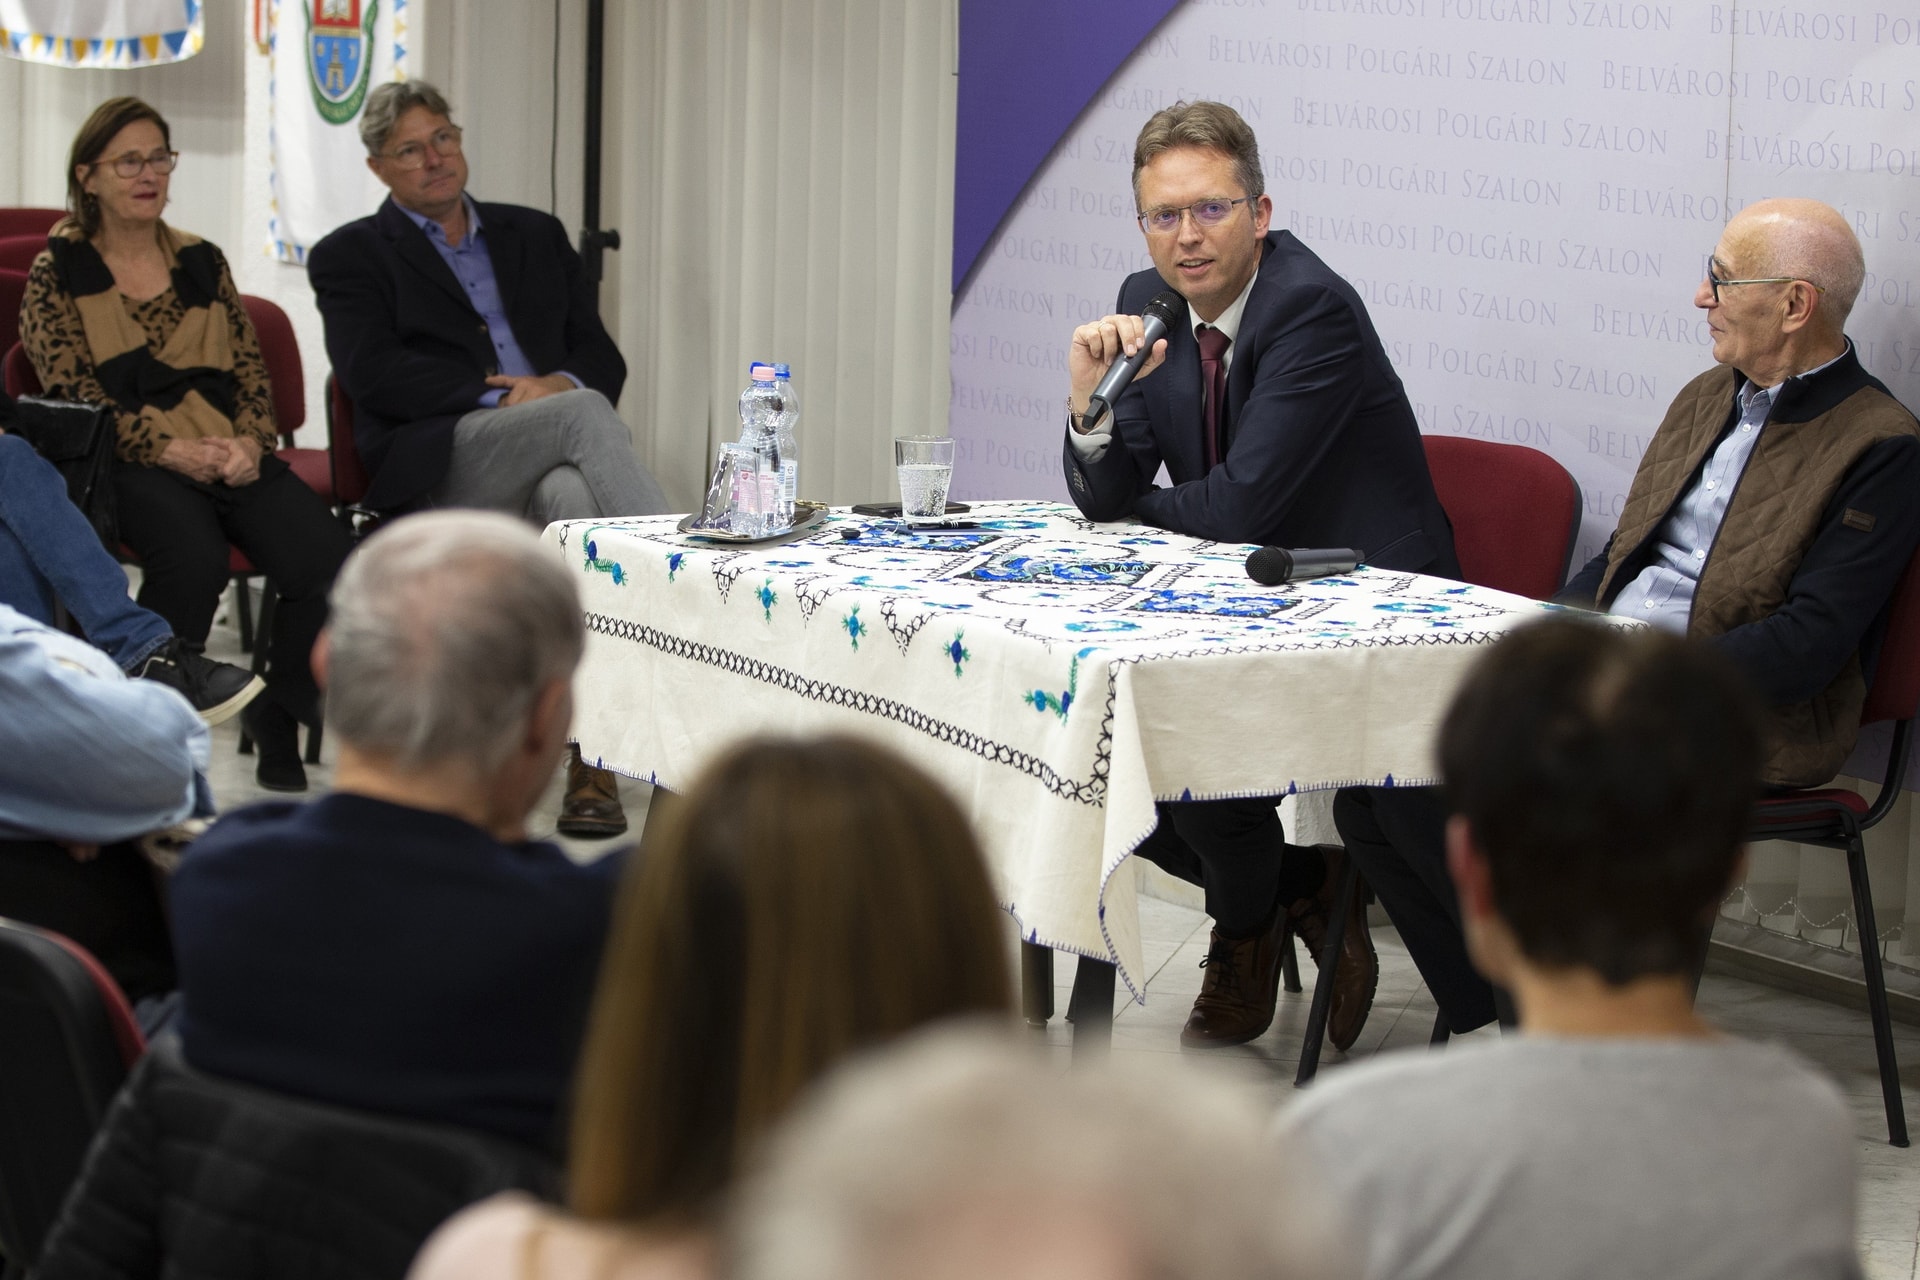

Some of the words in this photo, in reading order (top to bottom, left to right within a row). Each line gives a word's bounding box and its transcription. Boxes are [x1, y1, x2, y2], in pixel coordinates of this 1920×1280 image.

[1566, 0, 1673, 32] SZALON
[1710, 4, 1857, 42] BELVÁROSI
[1208, 34, 1331, 69] BELVÁROSI
[1346, 43, 1453, 78] POLGÁRI
[1466, 51, 1567, 86] SZALON
[1602, 59, 1751, 98] BELVÁROSI
[1766, 70, 1887, 109] POLGÁRI
[1293, 96, 1421, 134] BELVÁROSI
[1437, 108, 1547, 145] POLGÁRI
[1562, 117, 1668, 154] SZALON
[1705, 129, 1852, 171] BELVÁROSI
[1342, 158, 1447, 195] POLGÁRI
[1461, 169, 1562, 206] SZALON
[1289, 209, 1417, 250] BELVÁROSI
[1432, 224, 1543, 265] POLGÁRI
[1557, 238, 1662, 278] SZALON
[1003, 236, 1079, 266] OLGÁRI
[1352, 278, 1442, 312] OLGÁRI
[1457, 287, 1558, 327] SZALON
[1592, 303, 1712, 346] BELVÁRO
[959, 385, 1050, 421] ELVÁROSI
[989, 335, 1067, 372] POLGÁR
[1452, 403, 1552, 446] SZALON
[1427, 341, 1537, 384] POLGÁRI
[1552, 358, 1657, 401] SZALON
